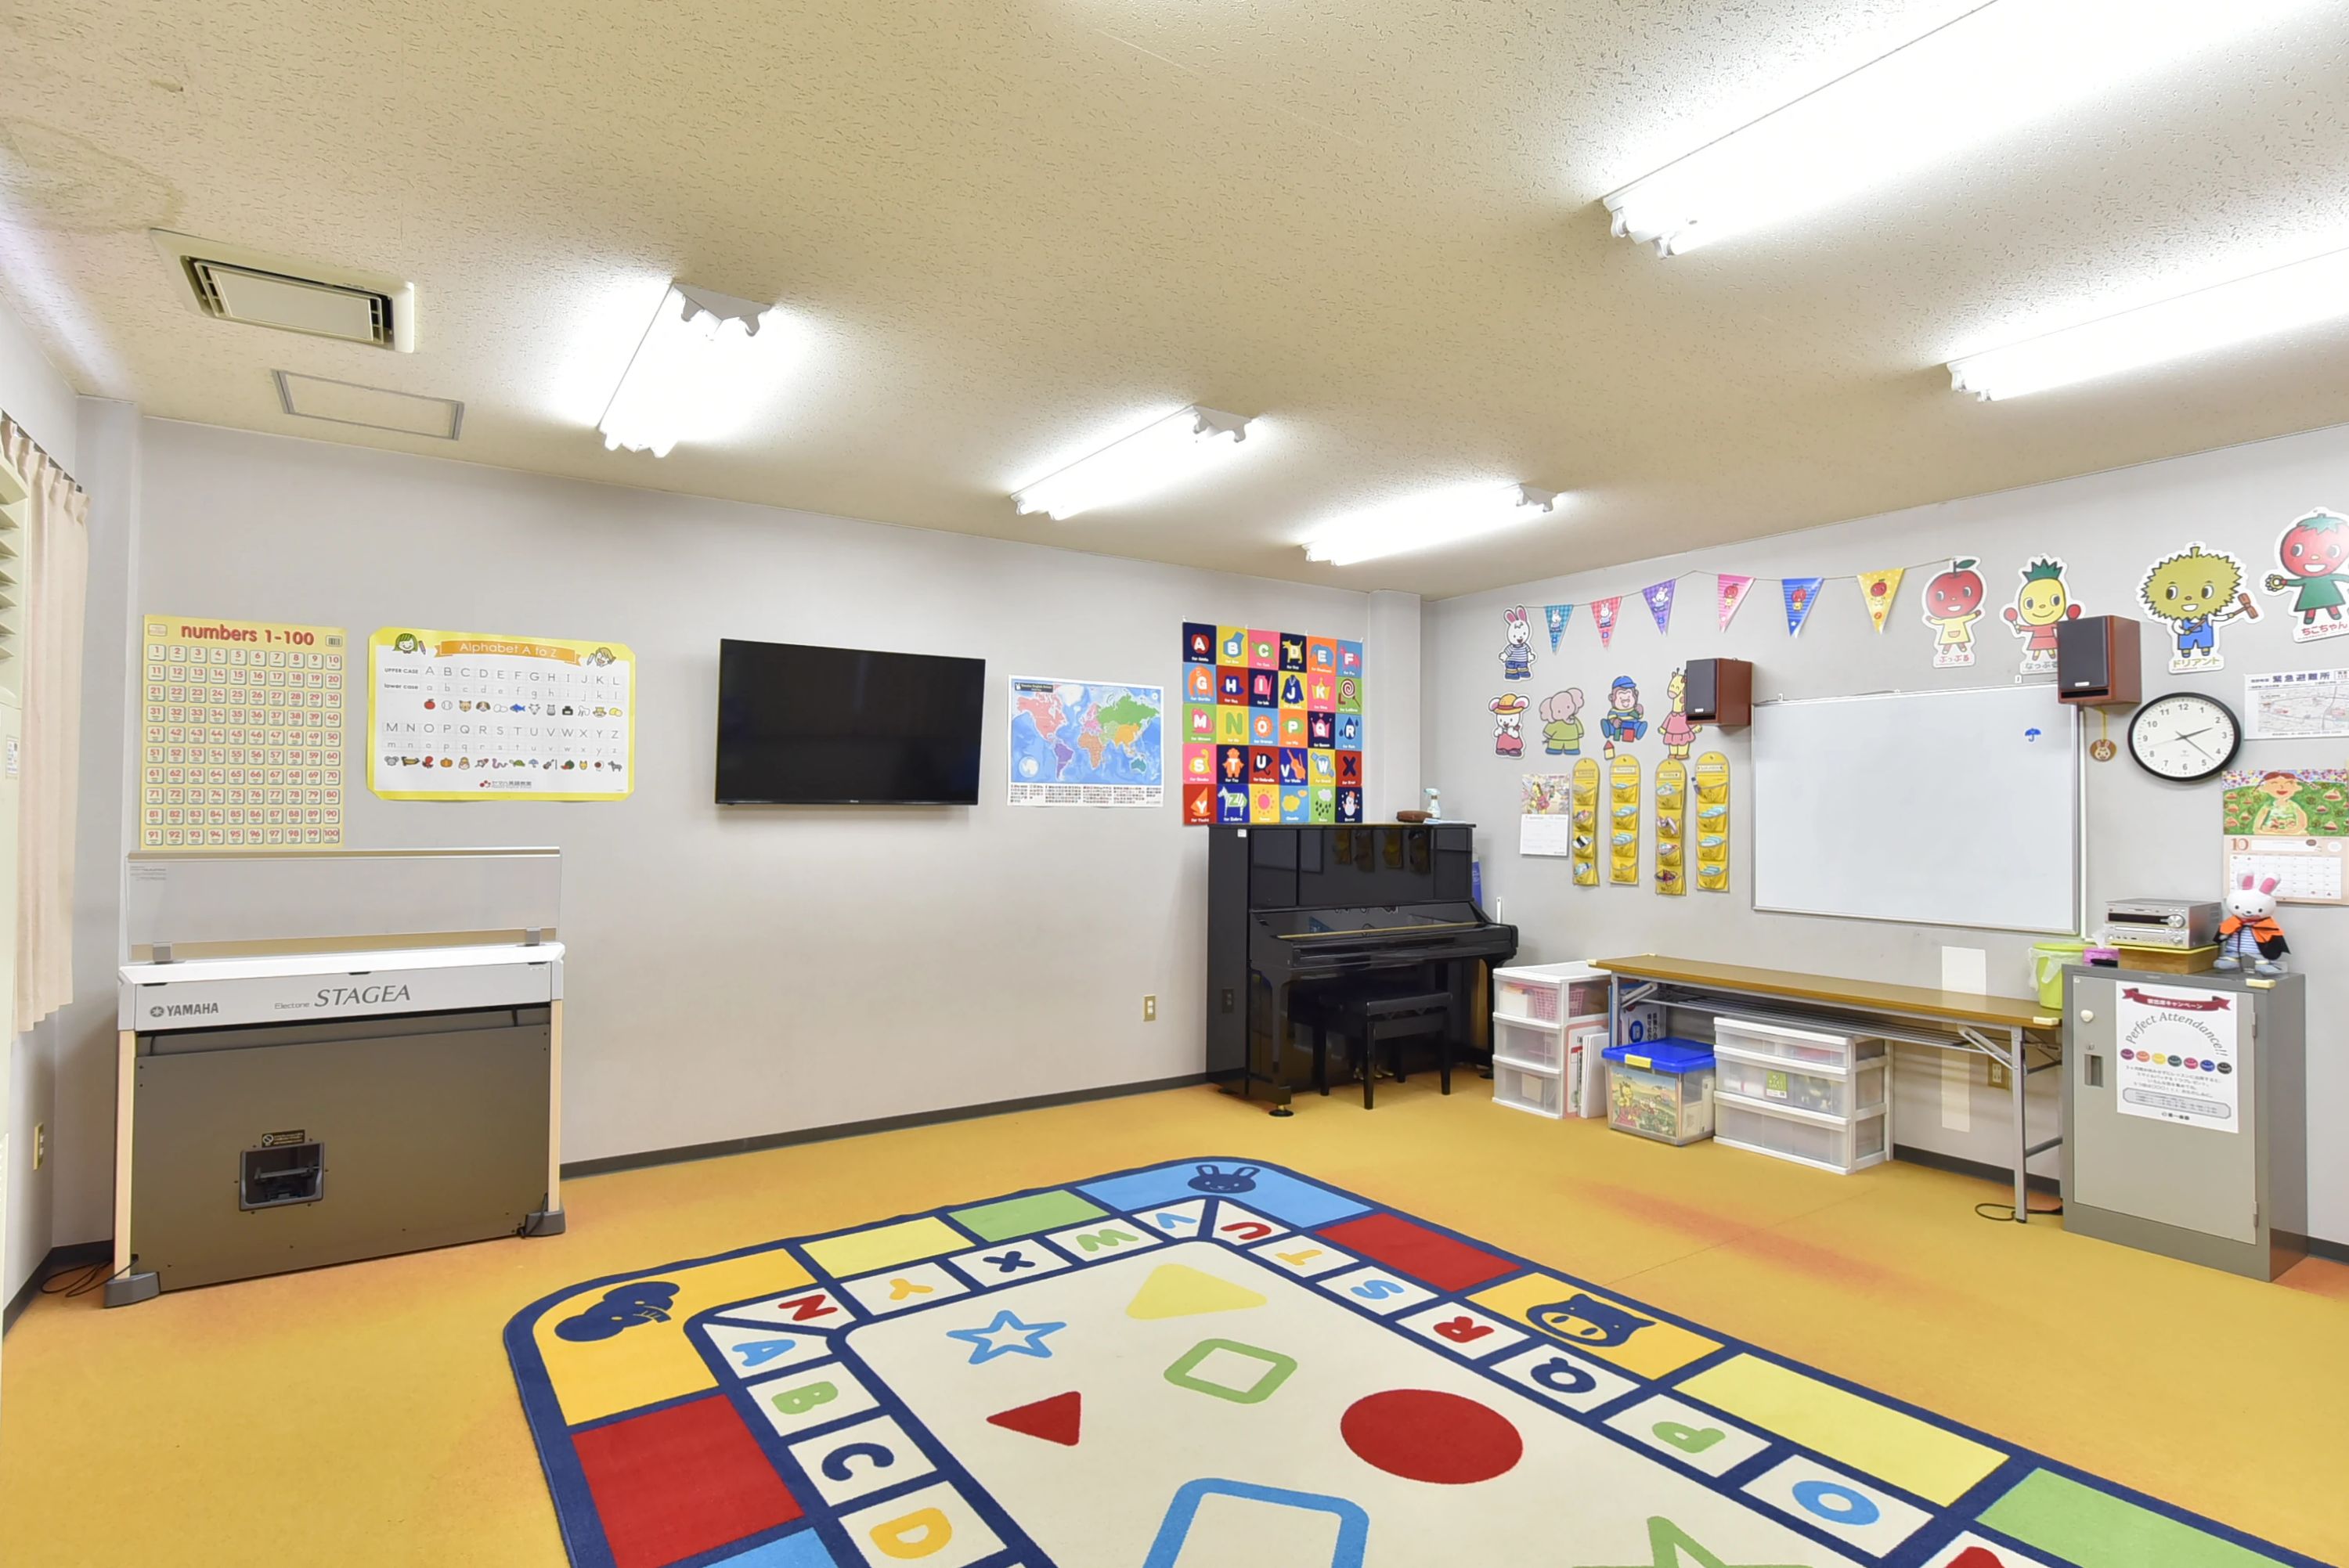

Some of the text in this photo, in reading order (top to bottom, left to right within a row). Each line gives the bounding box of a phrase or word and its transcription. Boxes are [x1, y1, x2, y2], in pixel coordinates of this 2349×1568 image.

[180, 624, 315, 646] numbers 1-100
[2301, 622, 2347, 636] ちこちゃん
[460, 643, 518, 654] Alphabet
[535, 647, 547, 657] to
[550, 649, 557, 658] Z
[1194, 637, 1205, 651] A
[1228, 642, 1238, 654] B
[1259, 644, 1269, 657] C
[1318, 651, 1326, 661] E
[1344, 653, 1353, 665] F
[2173, 657, 2220, 668] ドリアント
[425, 666, 435, 675] A
[444, 667, 452, 676] B
[460, 668, 470, 676] C
[480, 669, 488, 678] D
[497, 670, 504, 679] E
[529, 672, 539, 681] G
[2272, 672, 2330, 683] 緊急避難所
[1196, 676, 1207, 690] G
[1226, 679, 1236, 692] H
[1286, 688, 1295, 699] J
[1316, 687, 1326, 699] K
[1194, 714, 1206, 727] M
[1226, 712, 1242, 734] N
[1257, 720, 1267, 733] O
[1288, 721, 1298, 733] P
[424, 724, 435, 733] O
[460, 725, 470, 734] Q
[497, 726, 503, 735] S
[547, 728, 555, 737] V
[596, 730, 603, 738] Y
[1346, 726, 1354, 735] R
[1193, 759, 1203, 772] S
[1225, 759, 1237, 771] T
[1257, 755, 1266, 769] U
[1319, 759, 1328, 773] W
[1343, 756, 1356, 777] X
[1281, 765, 1290, 777] V
[1229, 795, 1238, 805] Z
[1196, 802, 1207, 813] Y
[2231, 838, 2249, 851] 10
[275, 985, 411, 1010] Electone STAGEA
[167, 1002, 219, 1016] YAMAHA
[2125, 1015, 2158, 1045] Perfect
[1156, 1213, 1196, 1229] V
[1221, 1222, 1271, 1239] U
[1077, 1230, 1138, 1251] W
[983, 1253, 1034, 1272] X
[1276, 1249, 1321, 1265] T
[889, 1278, 933, 1299] Y
[1351, 1281, 1404, 1299] S
[1434, 1317, 1492, 1343] R
[732, 1340, 794, 1366] A
[1530, 1358, 1596, 1393] Q
[772, 1382, 838, 1415] B
[1652, 1422, 1724, 1453] P
[821, 1444, 893, 1481] C
[1792, 1481, 1879, 1525] O
[869, 1509, 952, 1559] D
